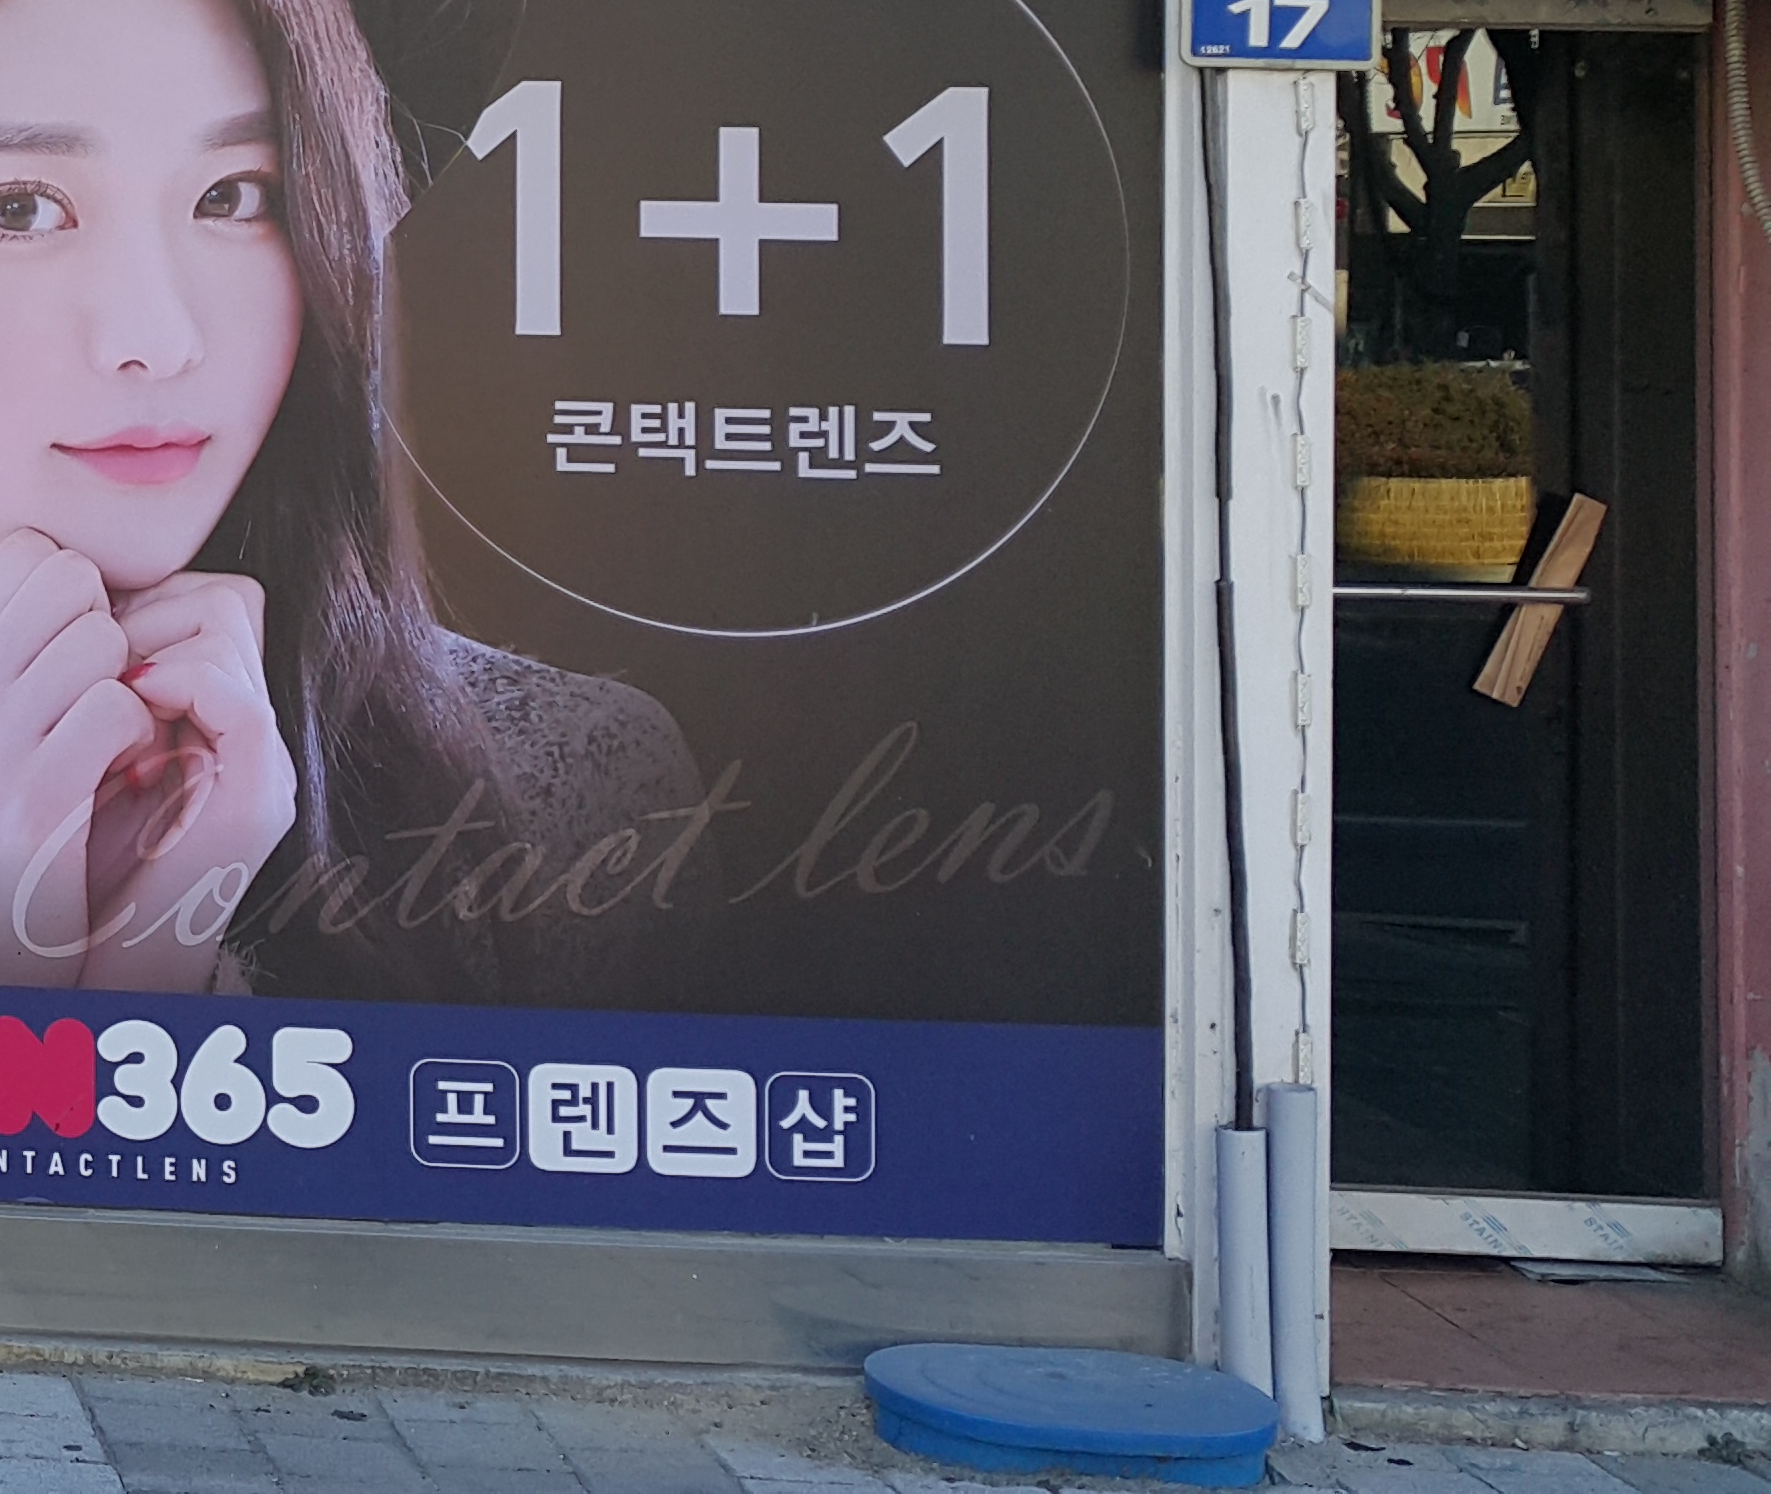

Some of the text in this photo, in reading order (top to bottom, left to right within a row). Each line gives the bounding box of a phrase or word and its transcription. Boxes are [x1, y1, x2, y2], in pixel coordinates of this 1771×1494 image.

[466, 79, 990, 347] 1+1
[545, 398, 942, 480] 콘택트렌즈
[12, 719, 1118, 960] Contact lens
